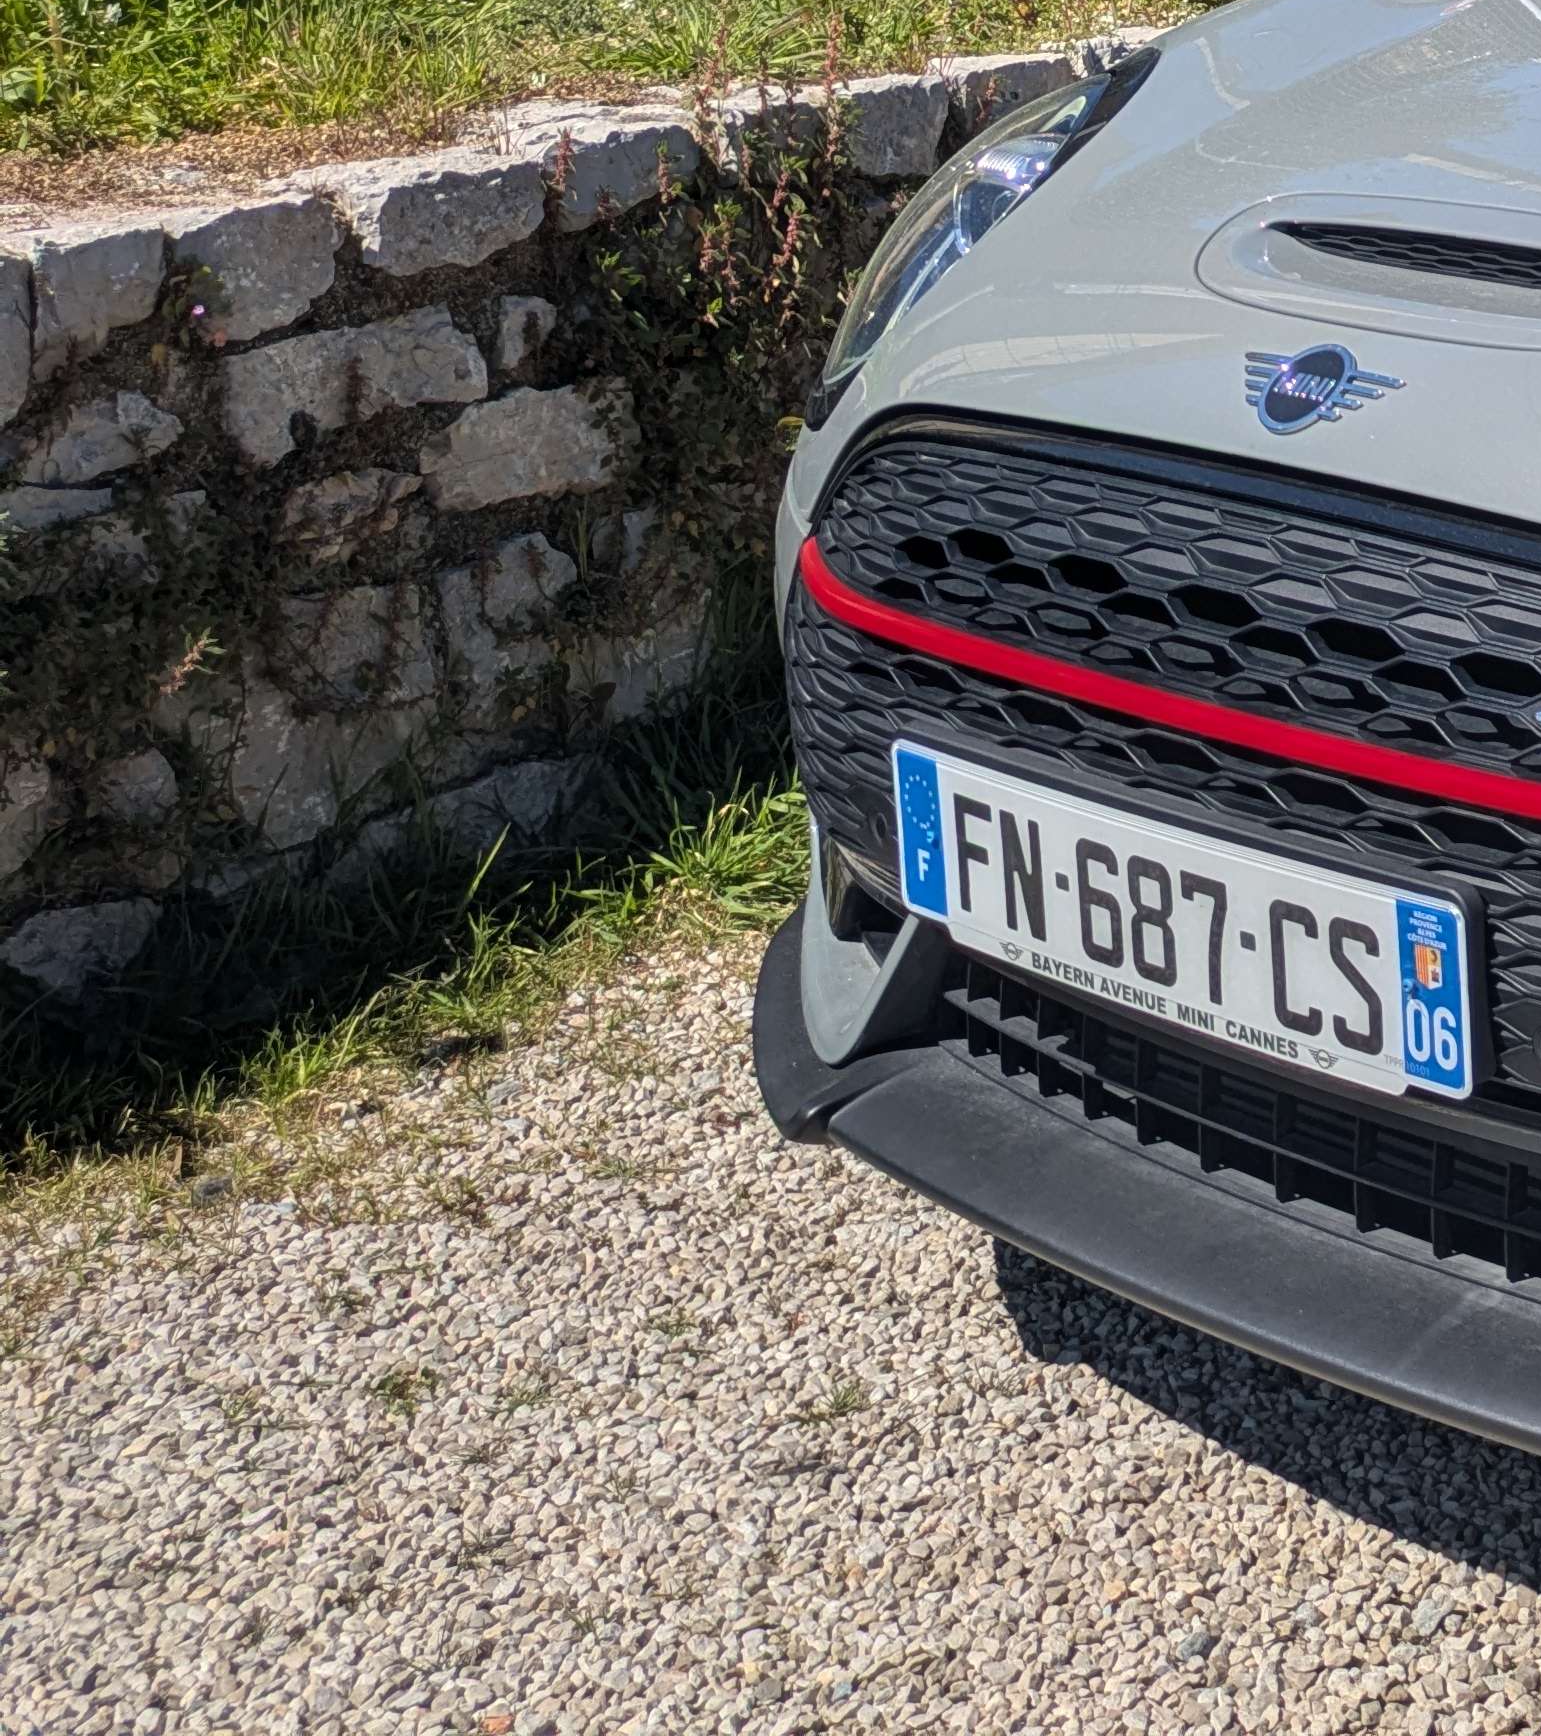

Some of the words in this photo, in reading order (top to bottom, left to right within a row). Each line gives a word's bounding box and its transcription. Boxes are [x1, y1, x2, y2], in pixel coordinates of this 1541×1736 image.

[917, 848, 931, 883] F
[1406, 999, 1458, 1071] 06
[1032, 951, 1095, 990] BAYERN
[1099, 976, 1167, 1015] AVENUE
[1176, 1002, 1215, 1032] MINI
[1225, 1020, 1299, 1059] CANNES
